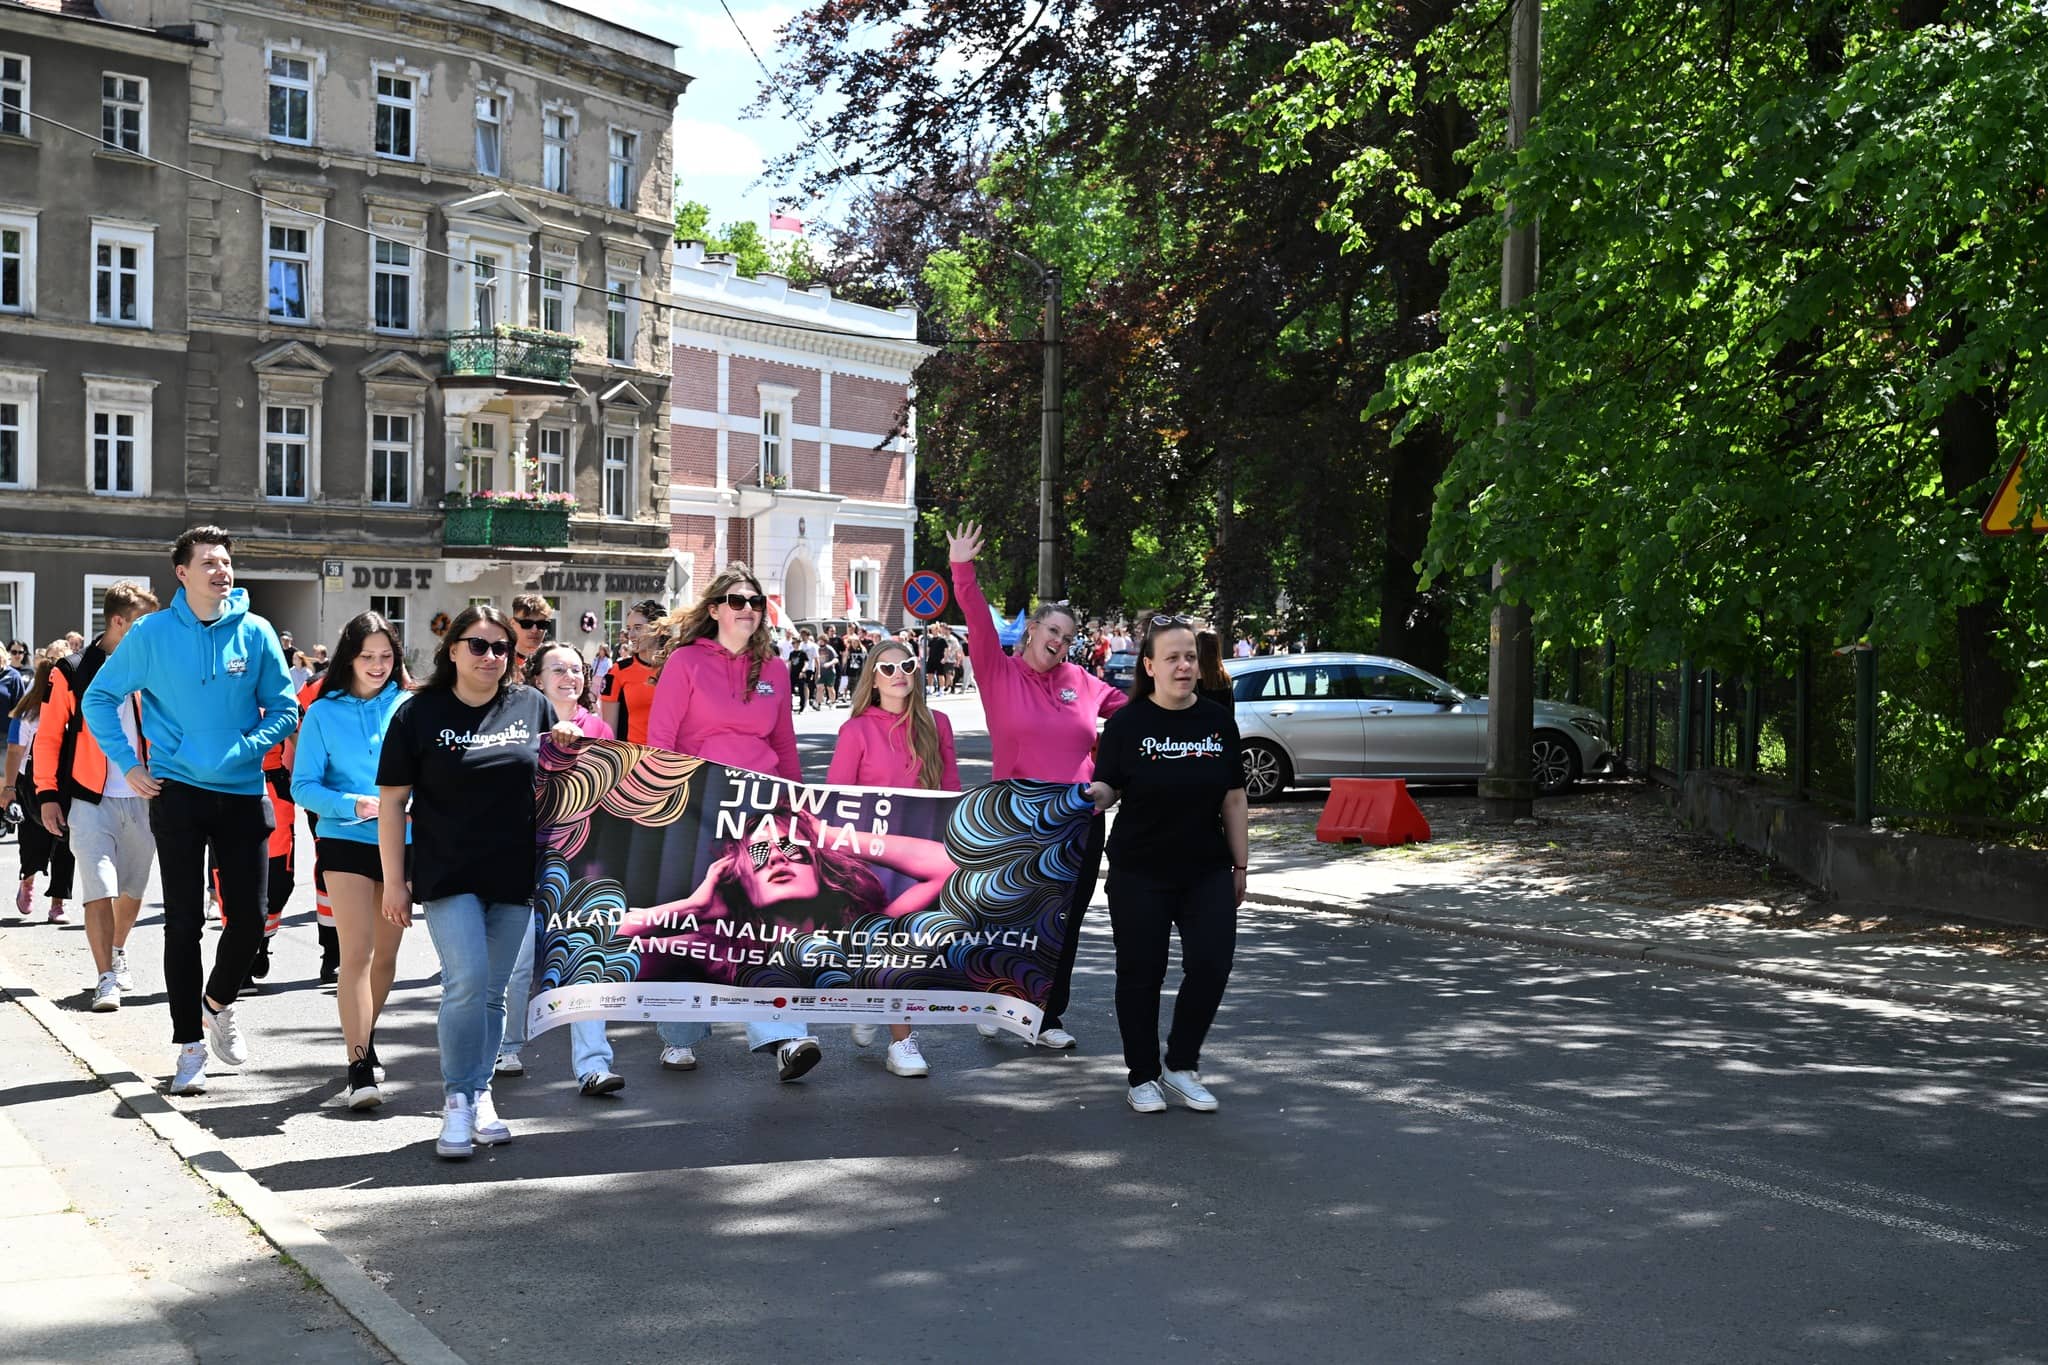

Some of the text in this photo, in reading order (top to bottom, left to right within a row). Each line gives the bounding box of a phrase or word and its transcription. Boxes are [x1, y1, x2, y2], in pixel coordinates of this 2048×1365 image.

[329, 565, 340, 576] 39
[352, 567, 432, 589] DUET
[440, 724, 530, 747] Pedagogika
[1142, 736, 1223, 757] Pedagogika
[715, 810, 861, 855] NALIA
[546, 908, 1039, 950] AKADEMIA NAUK STOSOWANYCH
[626, 935, 948, 969] ANGELUSA SILESIUSA
[928, 1004, 955, 1012] Gazeta
